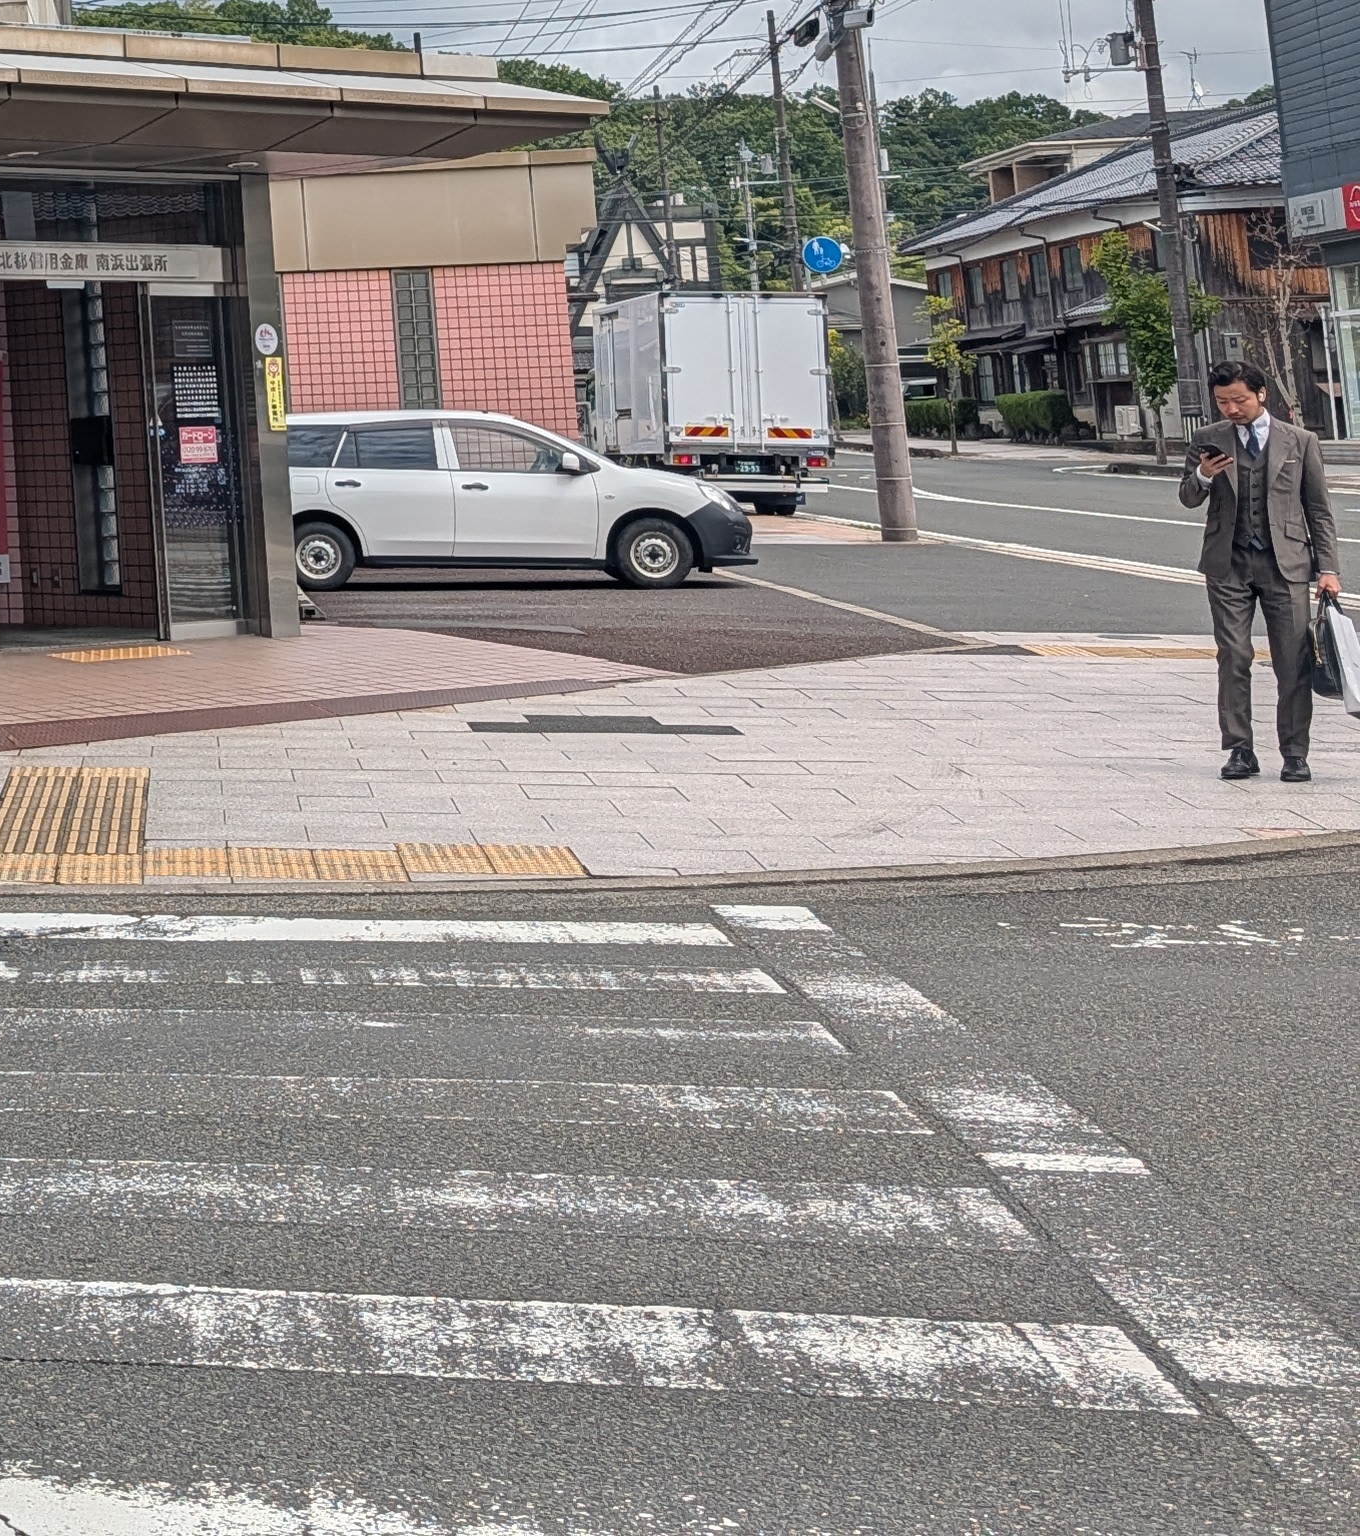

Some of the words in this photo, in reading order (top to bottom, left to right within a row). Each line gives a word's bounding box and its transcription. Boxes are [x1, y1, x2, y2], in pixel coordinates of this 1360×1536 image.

[95, 252, 168, 272] 南浜出張所
